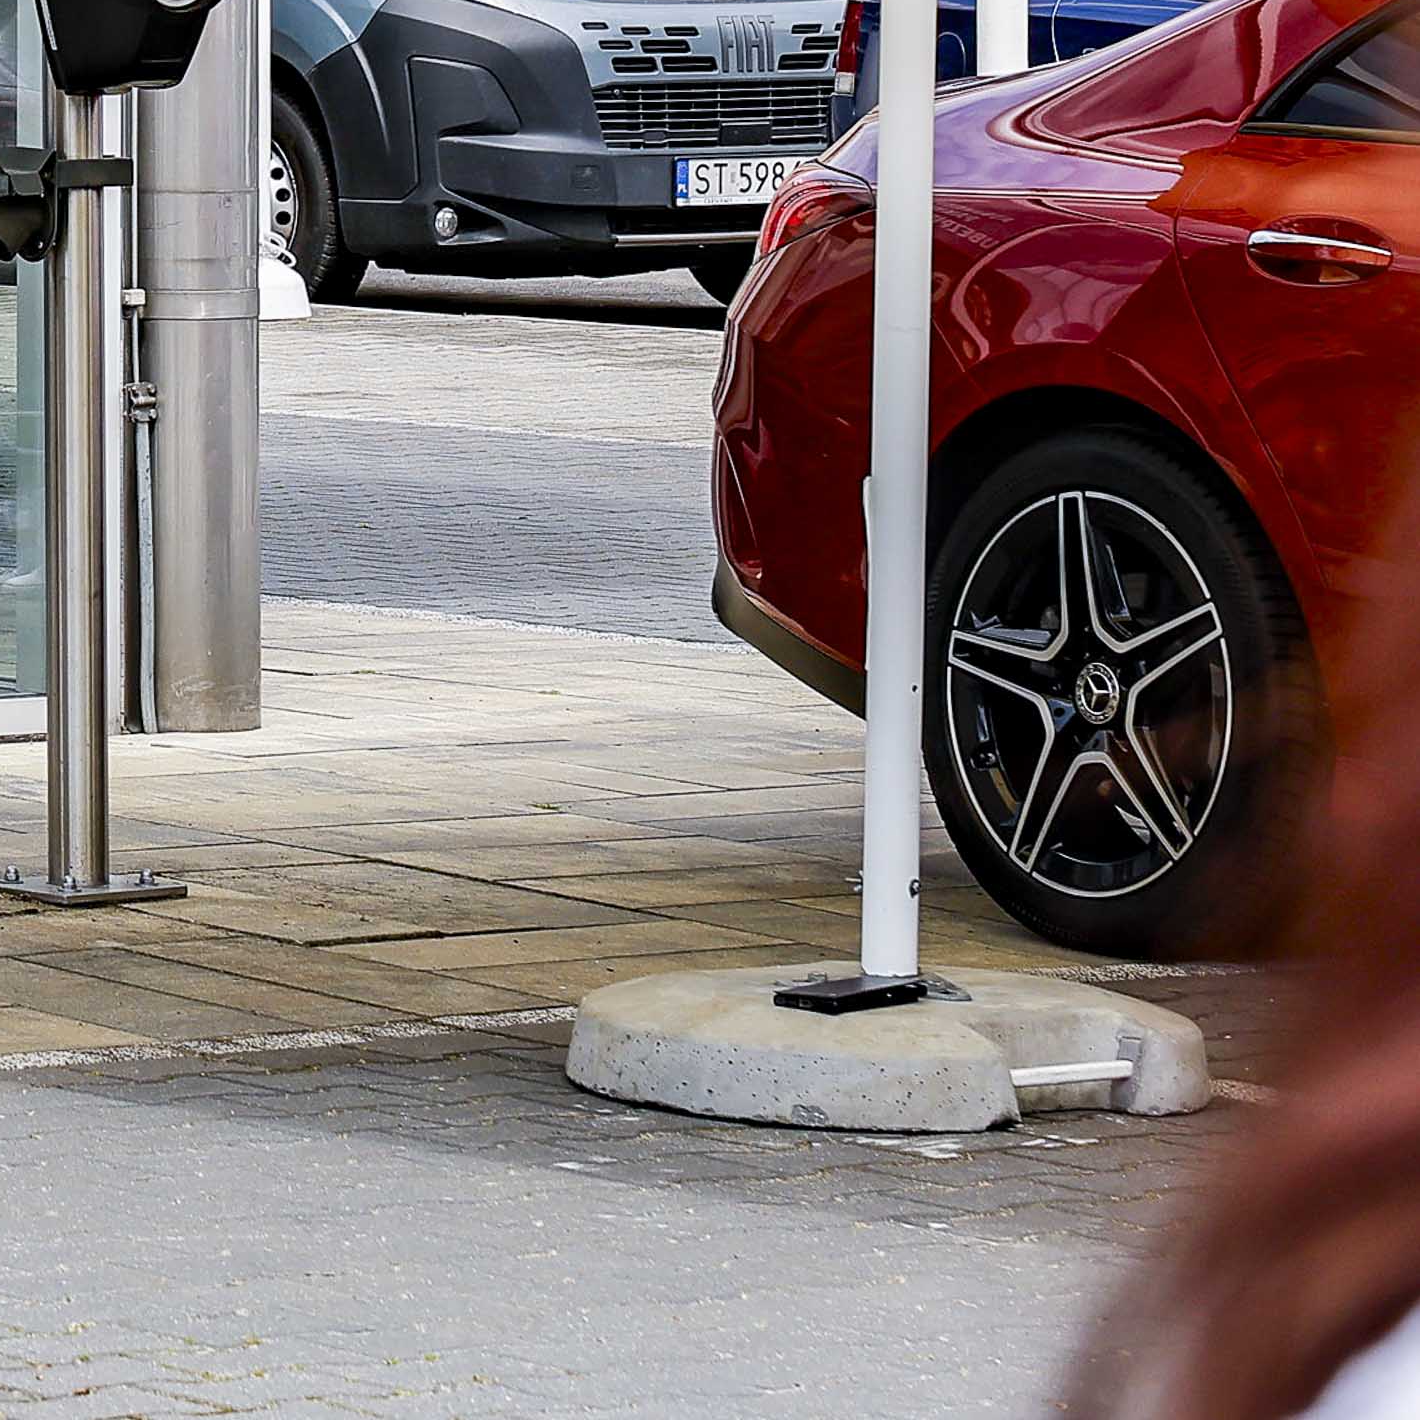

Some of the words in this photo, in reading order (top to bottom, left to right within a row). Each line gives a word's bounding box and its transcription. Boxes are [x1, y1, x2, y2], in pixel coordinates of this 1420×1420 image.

[716, 14, 776, 75] FIAT
[695, 163, 729, 195] ST
[739, 160, 801, 193] 598
